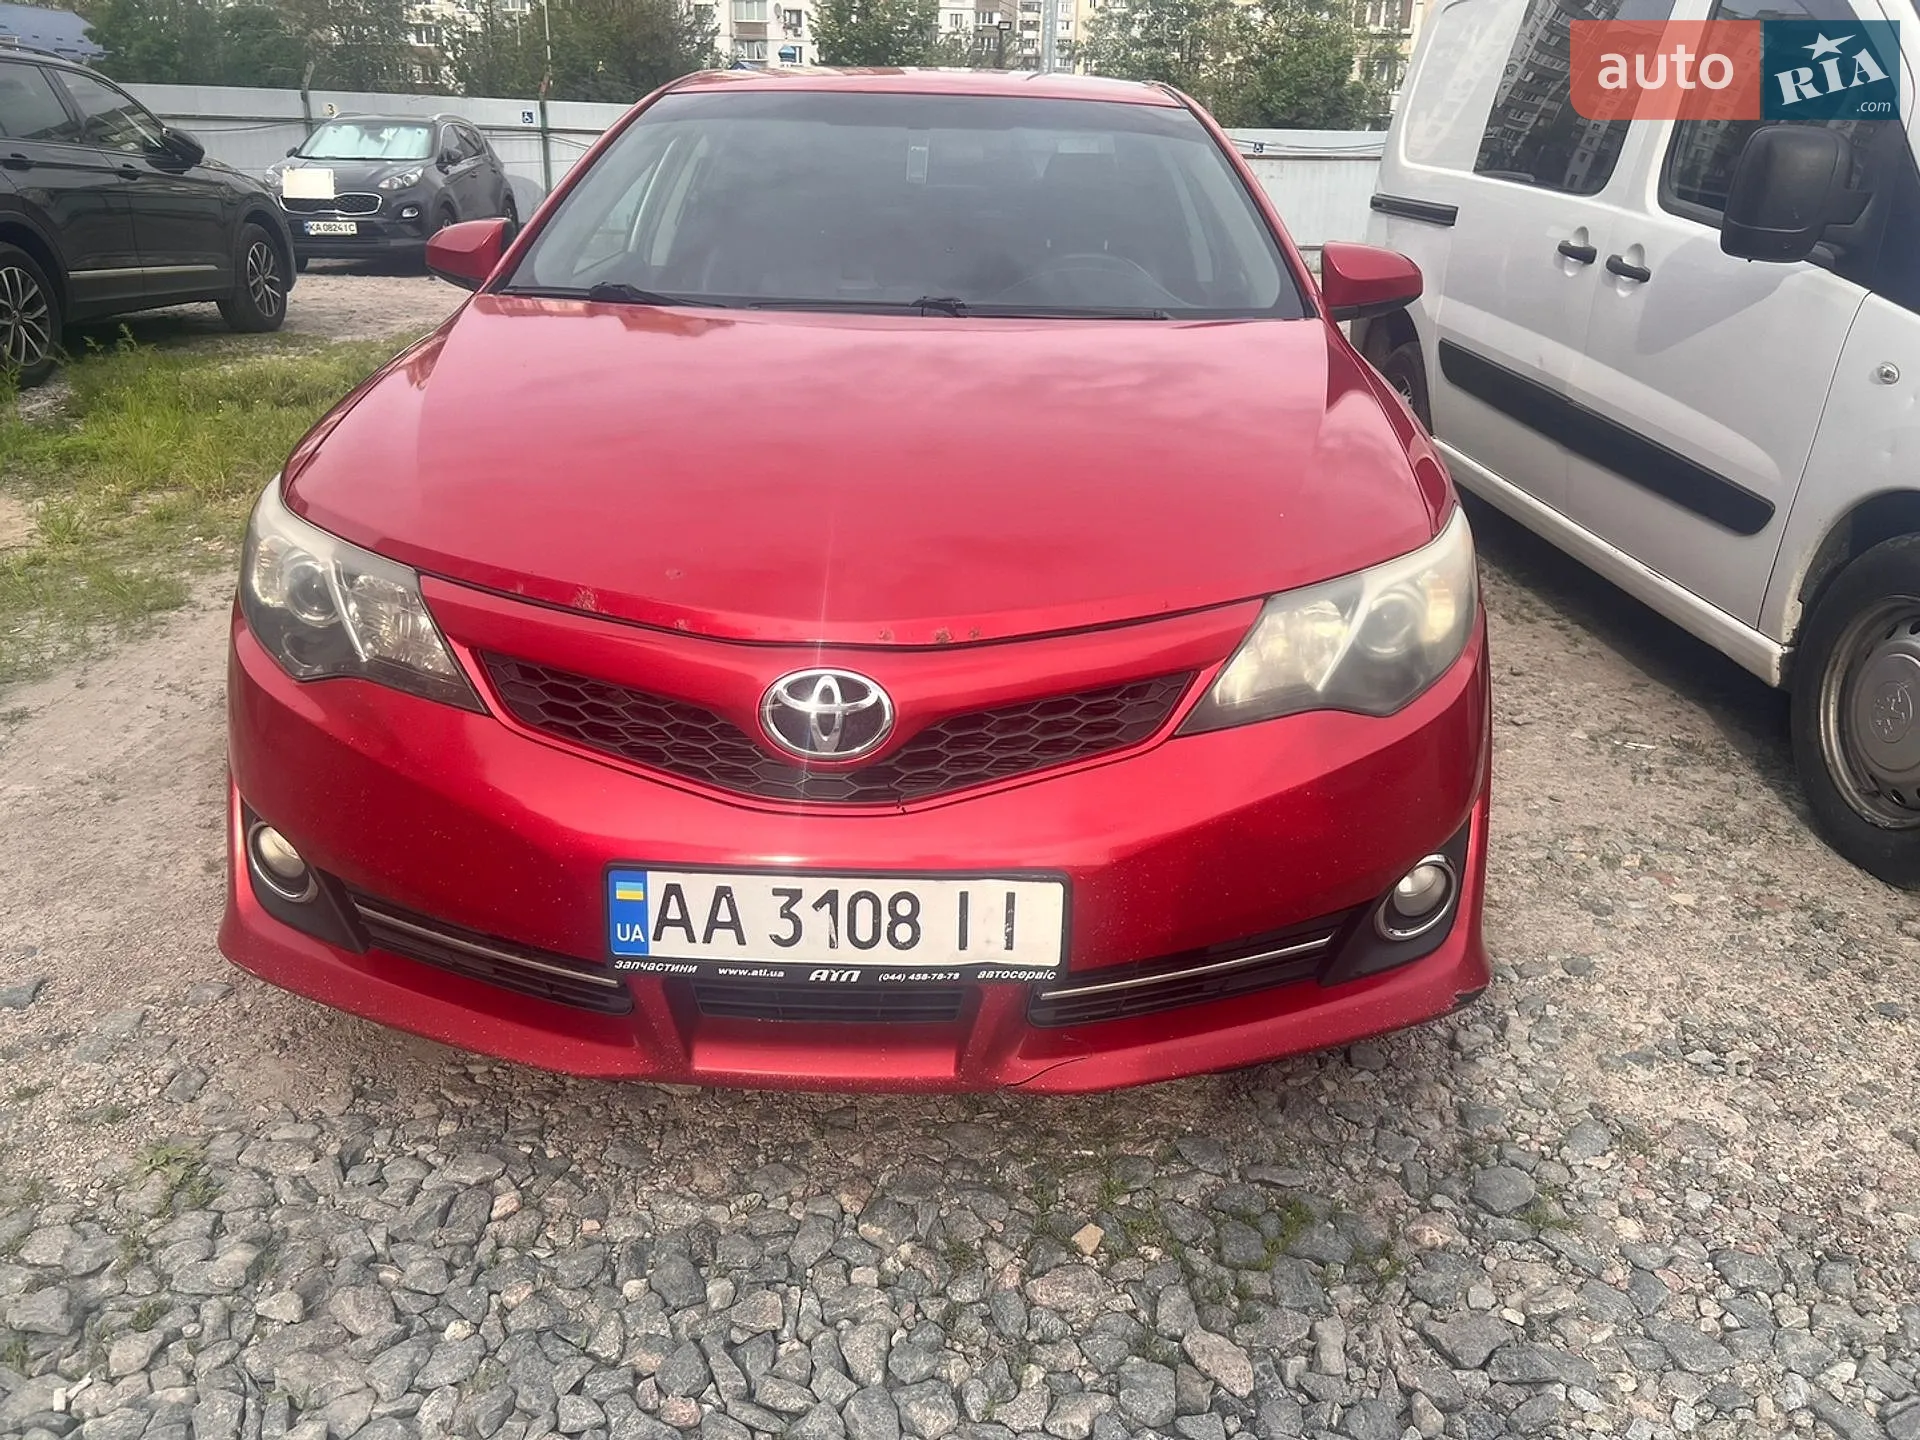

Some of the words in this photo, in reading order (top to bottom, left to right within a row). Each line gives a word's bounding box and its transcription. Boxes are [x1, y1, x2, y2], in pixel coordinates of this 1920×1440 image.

[652, 882, 747, 946] AA
[769, 887, 921, 951] 3108
[616, 923, 646, 943] UA
[877, 972, 907, 983] (044)
